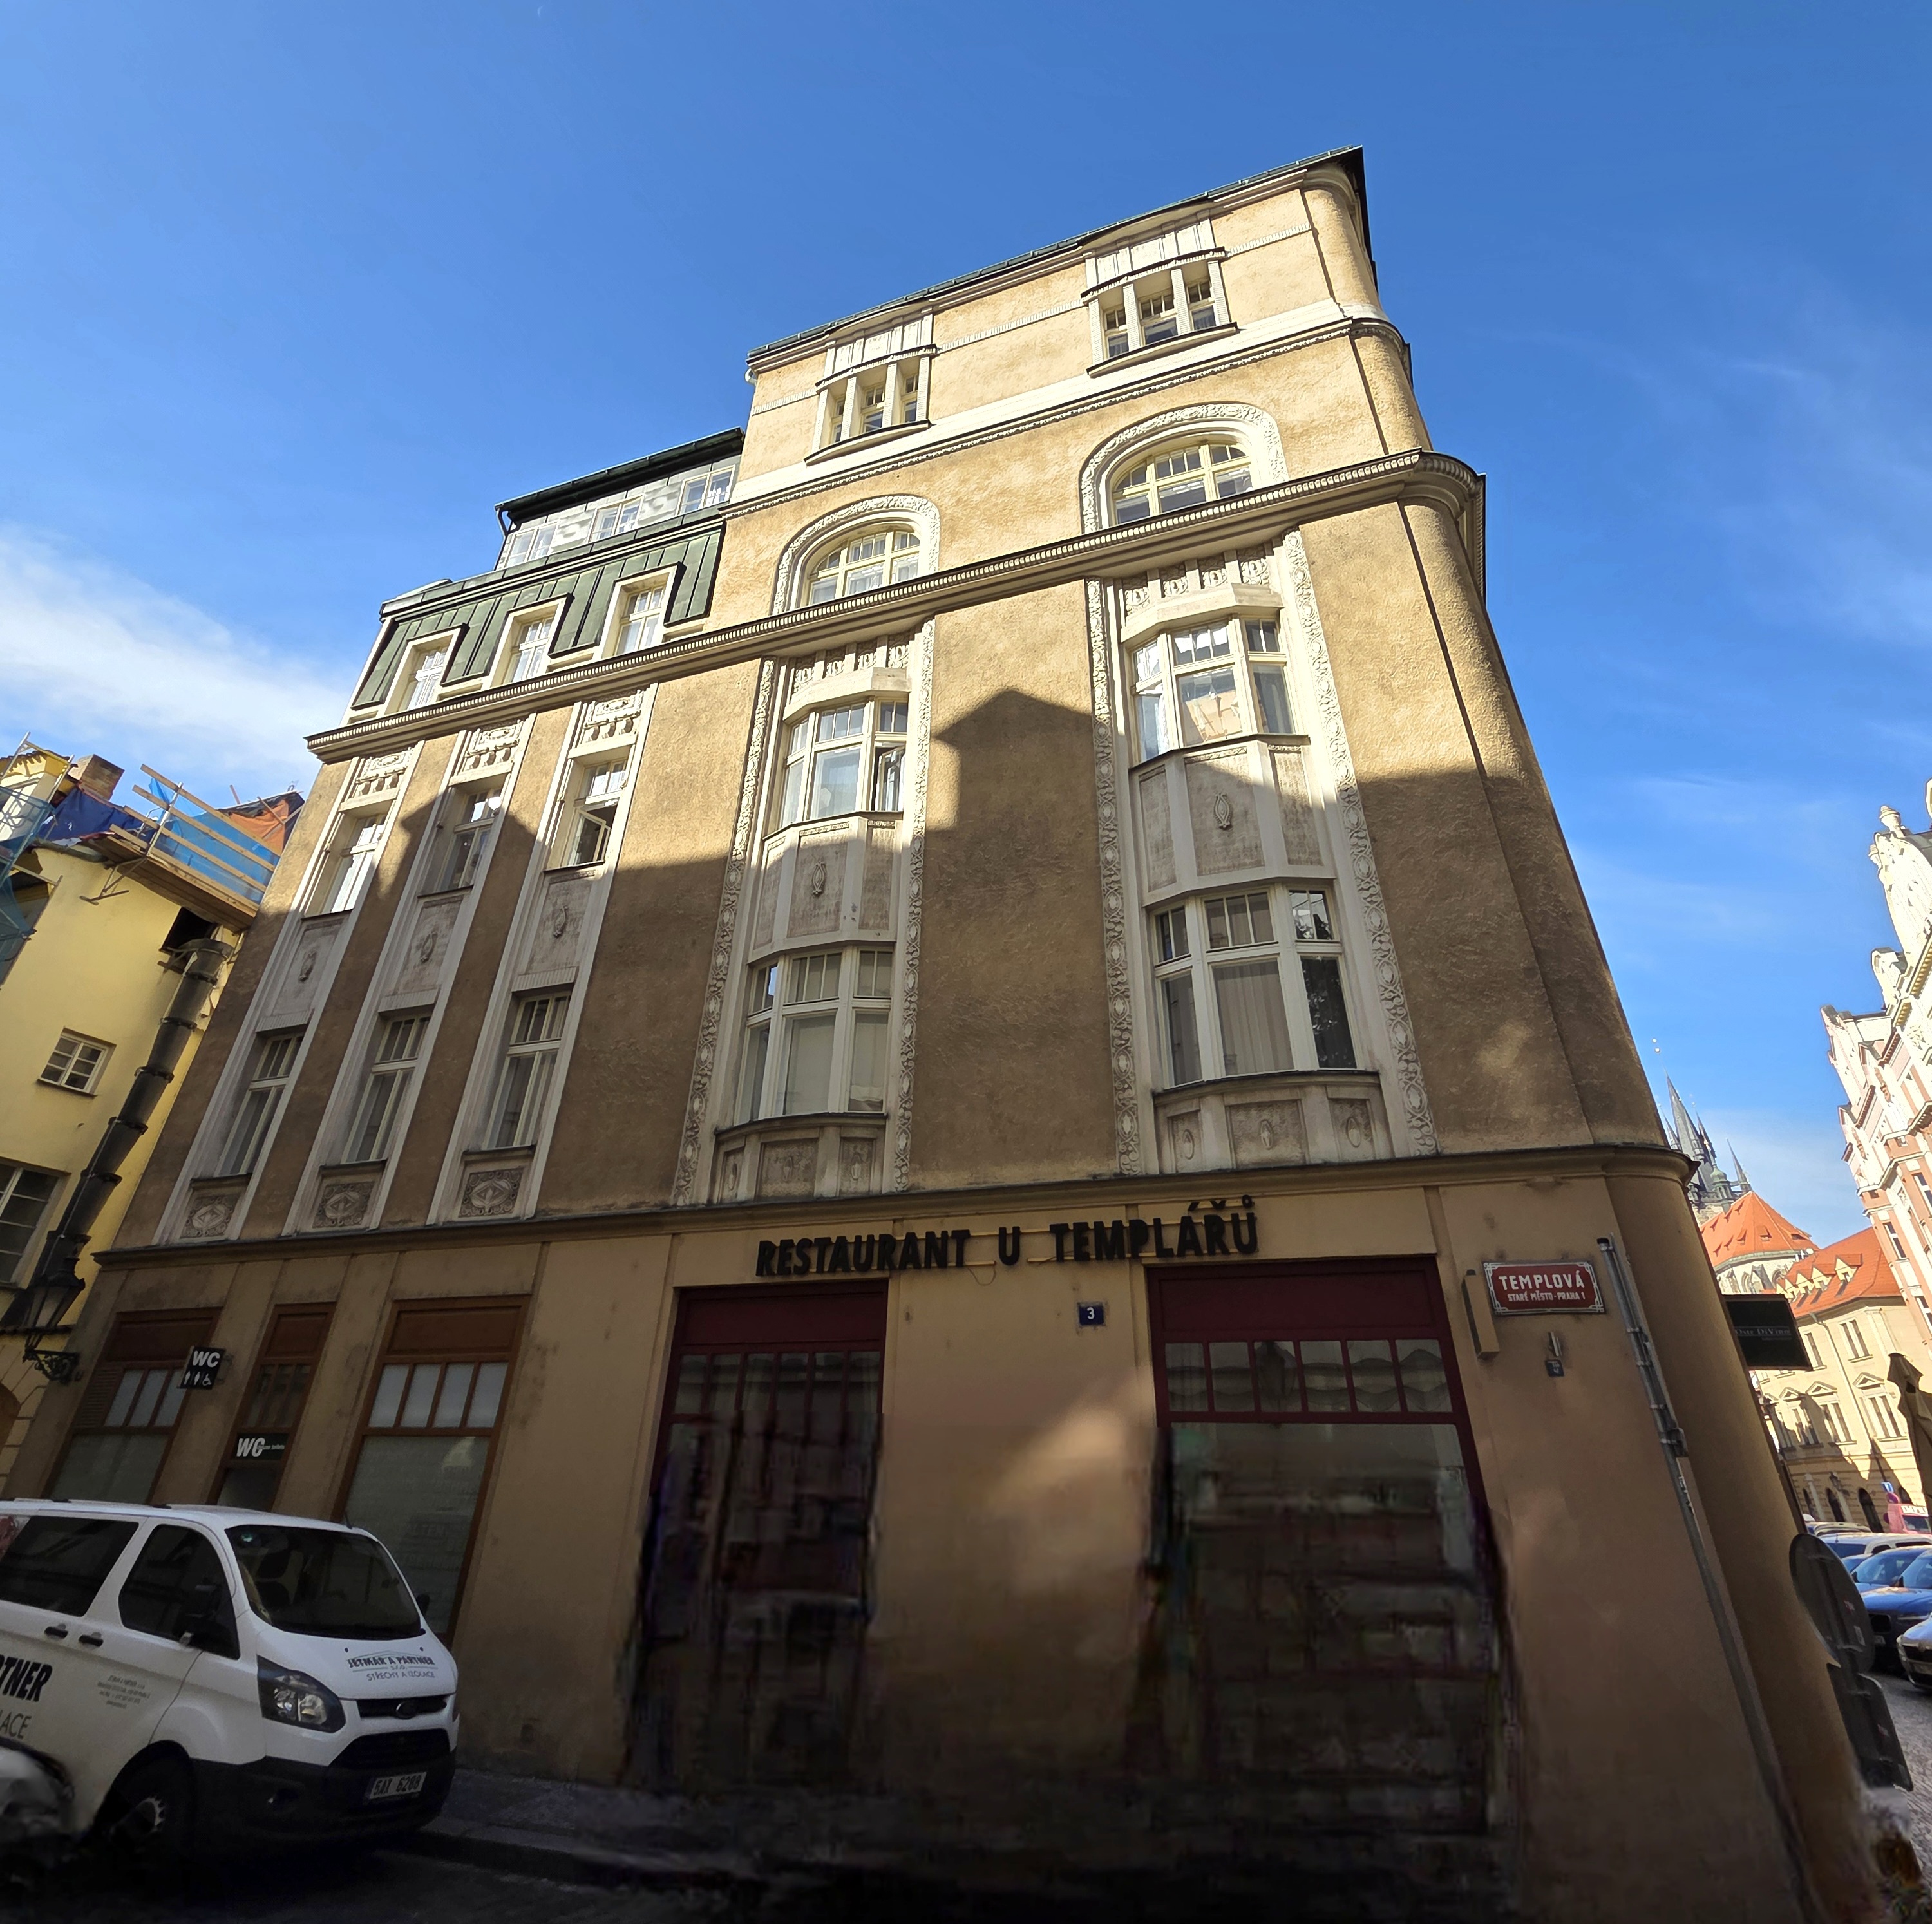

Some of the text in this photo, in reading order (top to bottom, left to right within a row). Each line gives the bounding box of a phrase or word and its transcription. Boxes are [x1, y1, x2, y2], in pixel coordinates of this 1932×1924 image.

[756, 1194, 1258, 1276] RESTAURANT U TEMPLÁŘŮ
[1498, 1270, 1585, 1290] TEMPLOVÁ
[1508, 1291, 1529, 1302] STARÉ
[1086, 1306, 1095, 1320] 3
[192, 1350, 220, 1368] WC
[236, 1437, 265, 1457] WC
